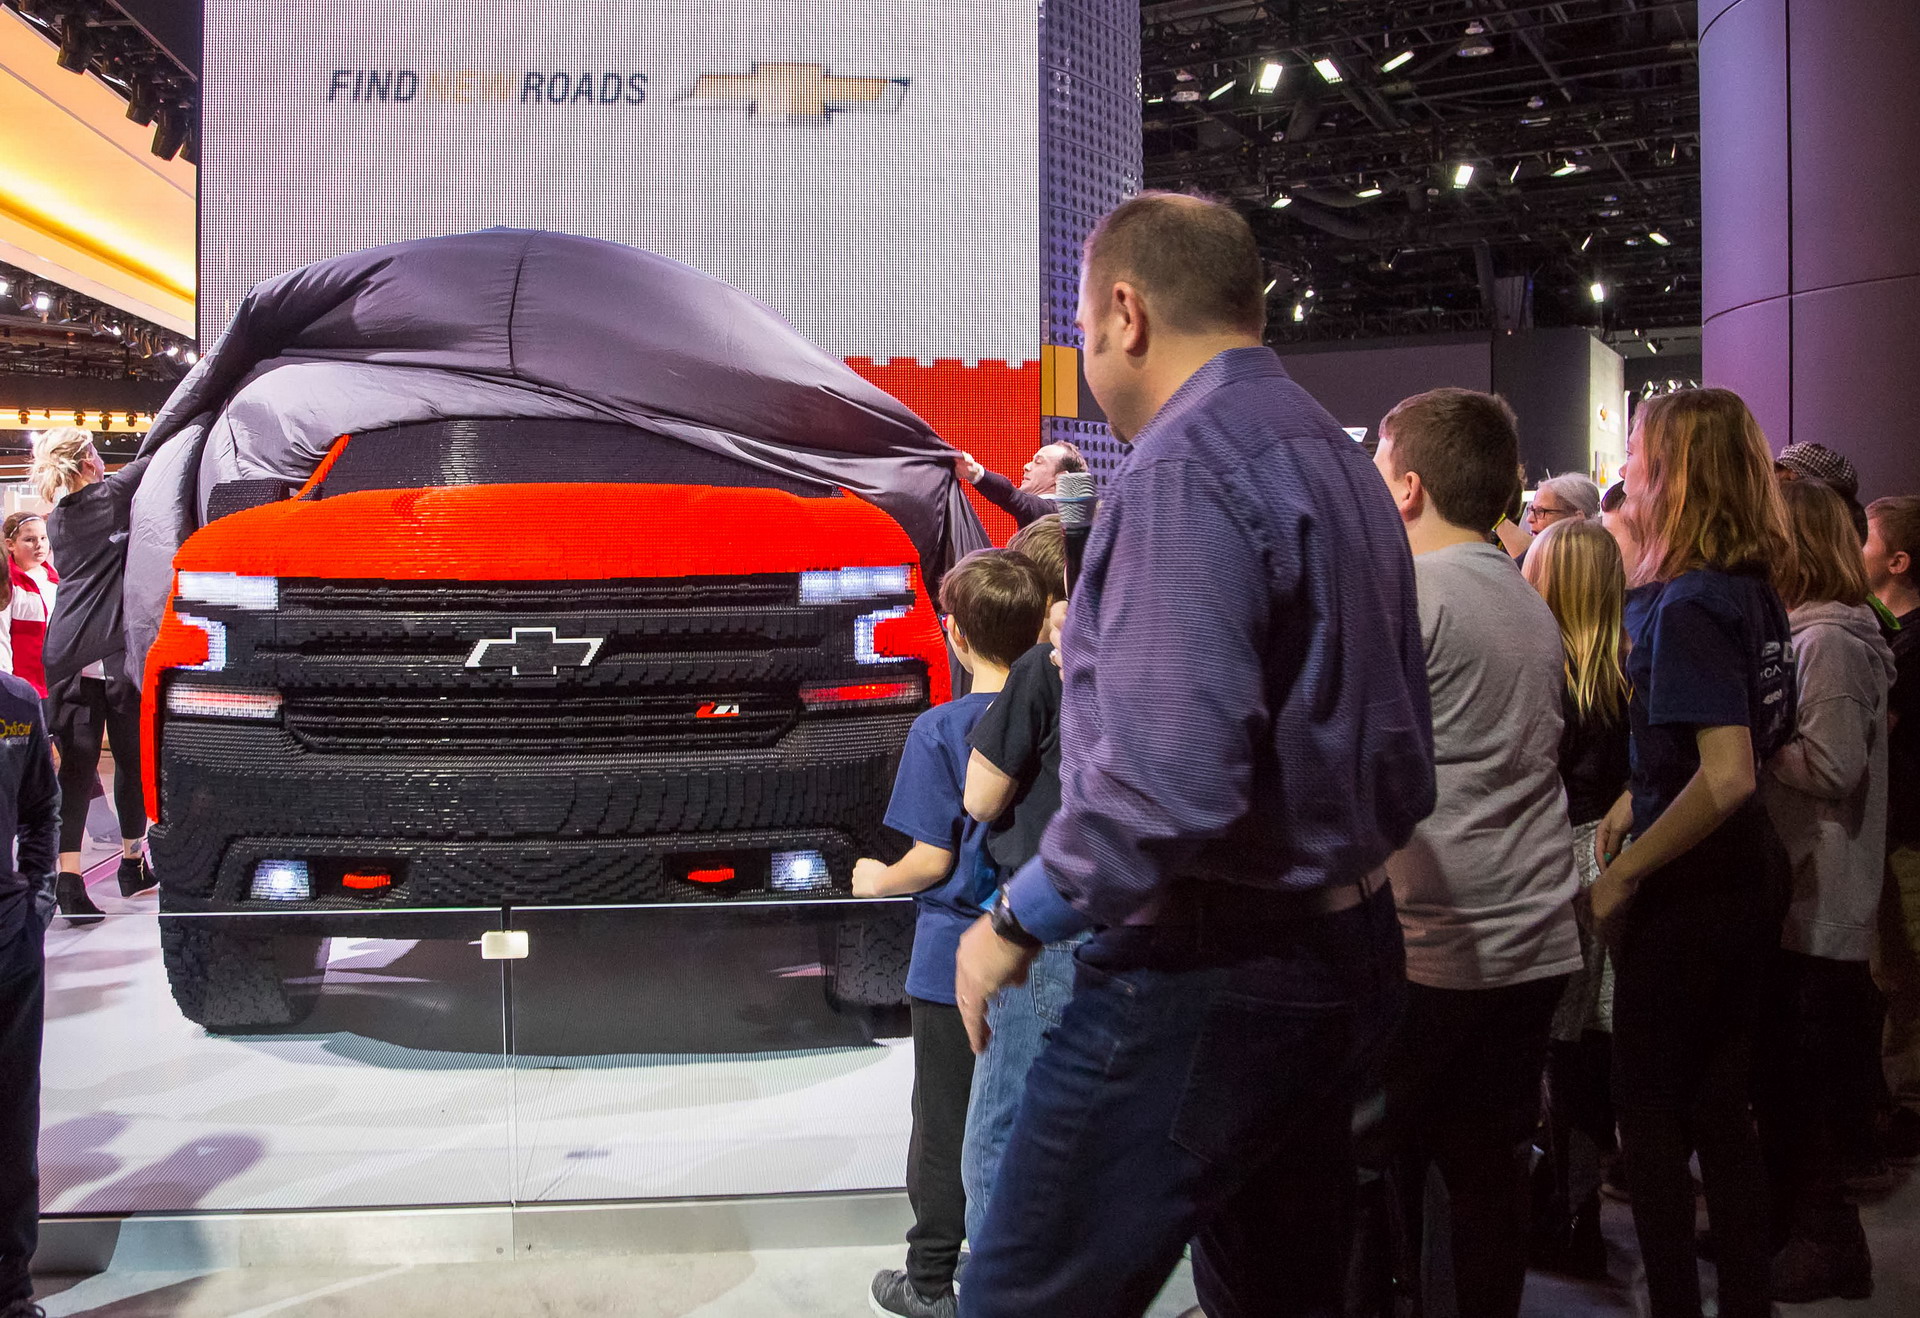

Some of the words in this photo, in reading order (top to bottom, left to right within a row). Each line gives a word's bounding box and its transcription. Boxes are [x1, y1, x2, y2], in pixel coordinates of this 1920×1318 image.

[329, 70, 418, 102] FIND
[427, 70, 516, 102] NEW
[521, 71, 648, 104] ROADS
